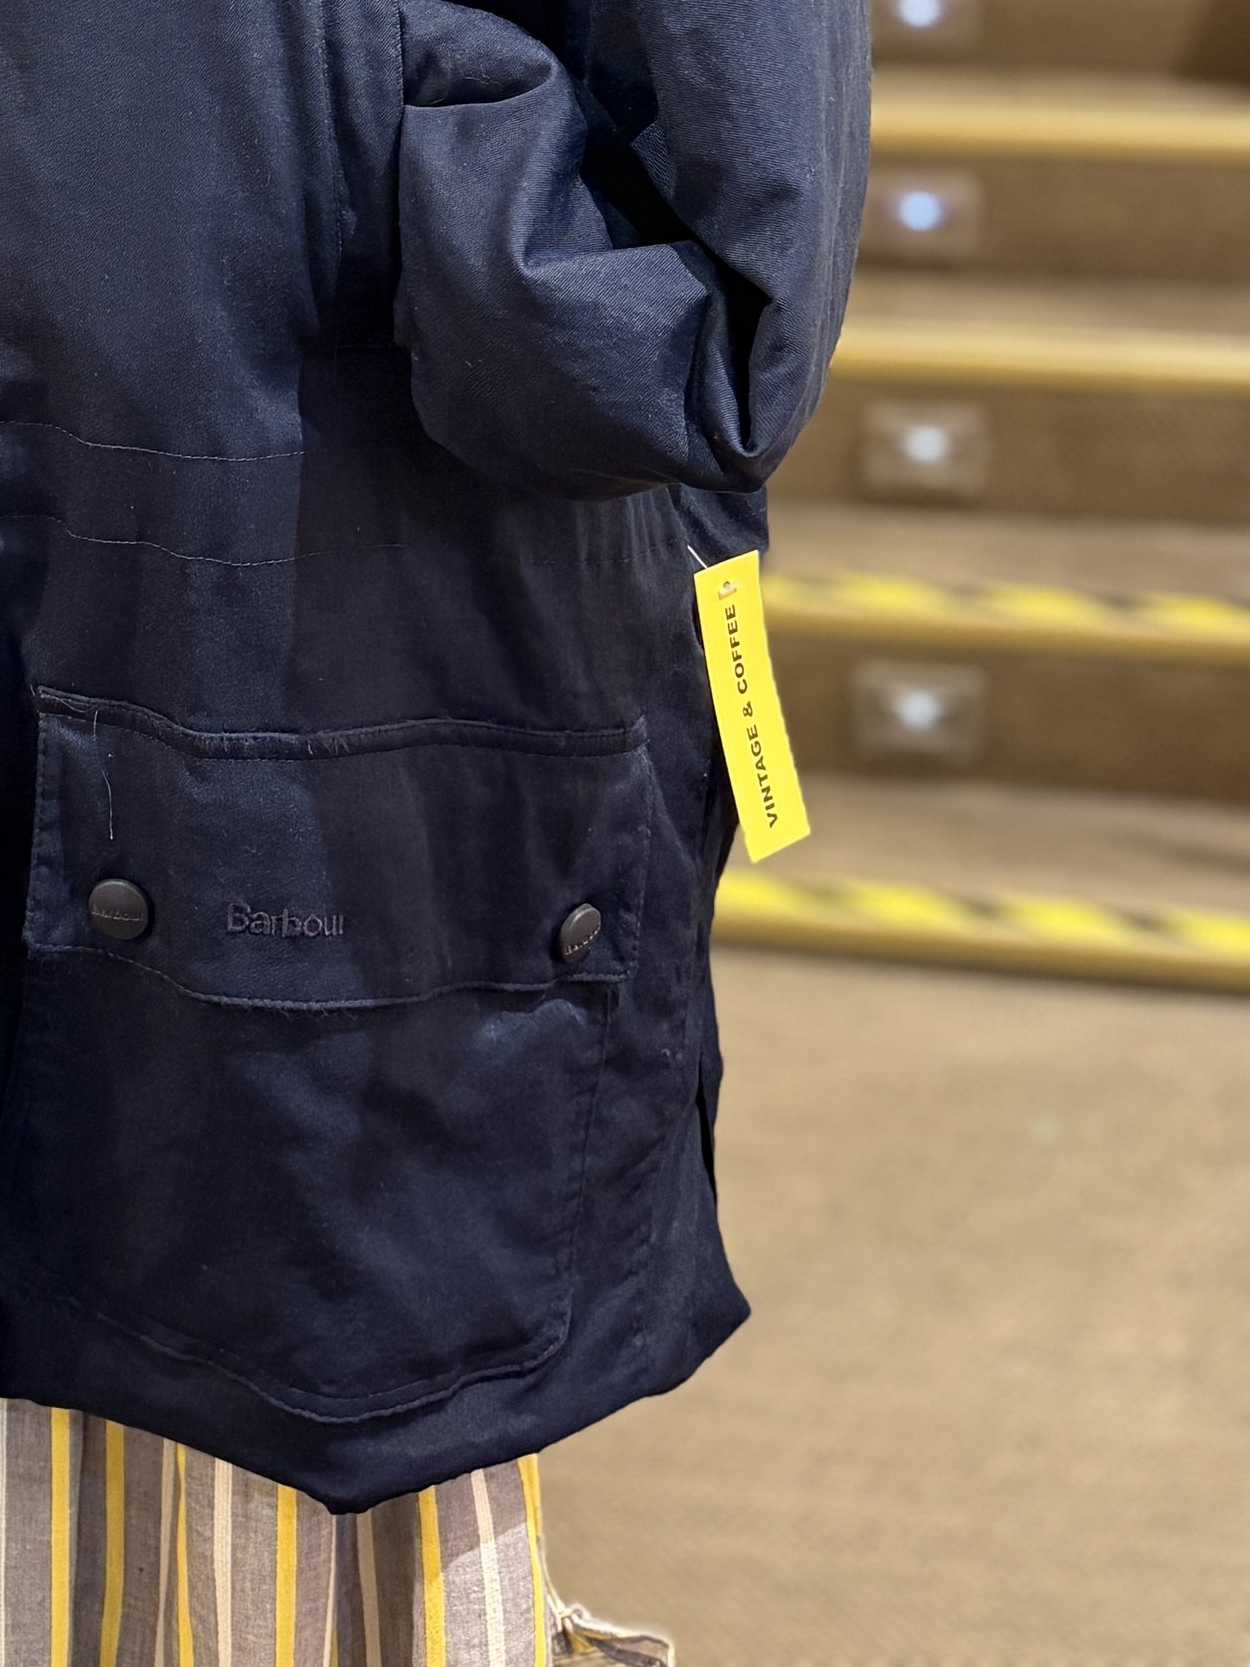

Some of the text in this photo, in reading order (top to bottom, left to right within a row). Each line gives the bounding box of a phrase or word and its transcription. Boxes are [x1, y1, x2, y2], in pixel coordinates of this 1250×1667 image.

[724, 604, 778, 828] VINTAGE & COFFEE
[227, 901, 345, 938] Barbour
